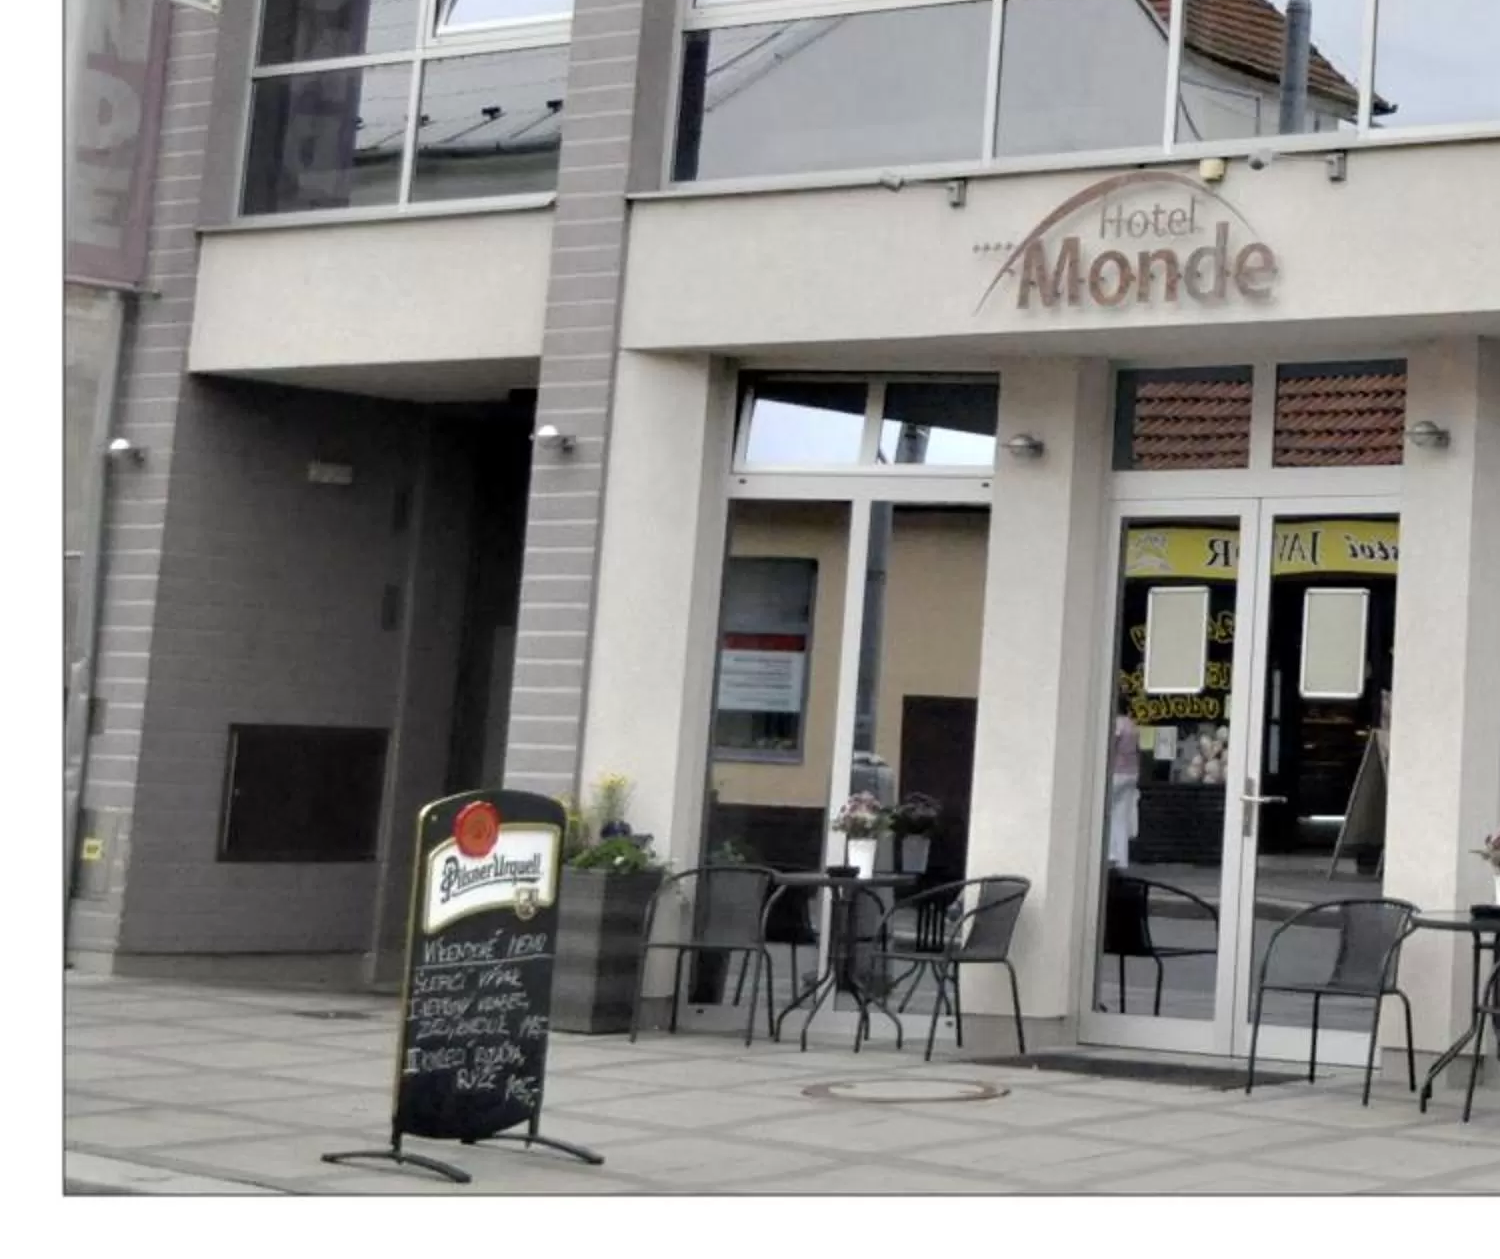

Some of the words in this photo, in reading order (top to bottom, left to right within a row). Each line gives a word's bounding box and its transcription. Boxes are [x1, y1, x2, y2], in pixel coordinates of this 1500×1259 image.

[1101, 195, 1200, 239] Hotel
[1016, 221, 1276, 309] Monde
[440, 855, 495, 903] Pilsner
[493, 852, 542, 887] Urquell
